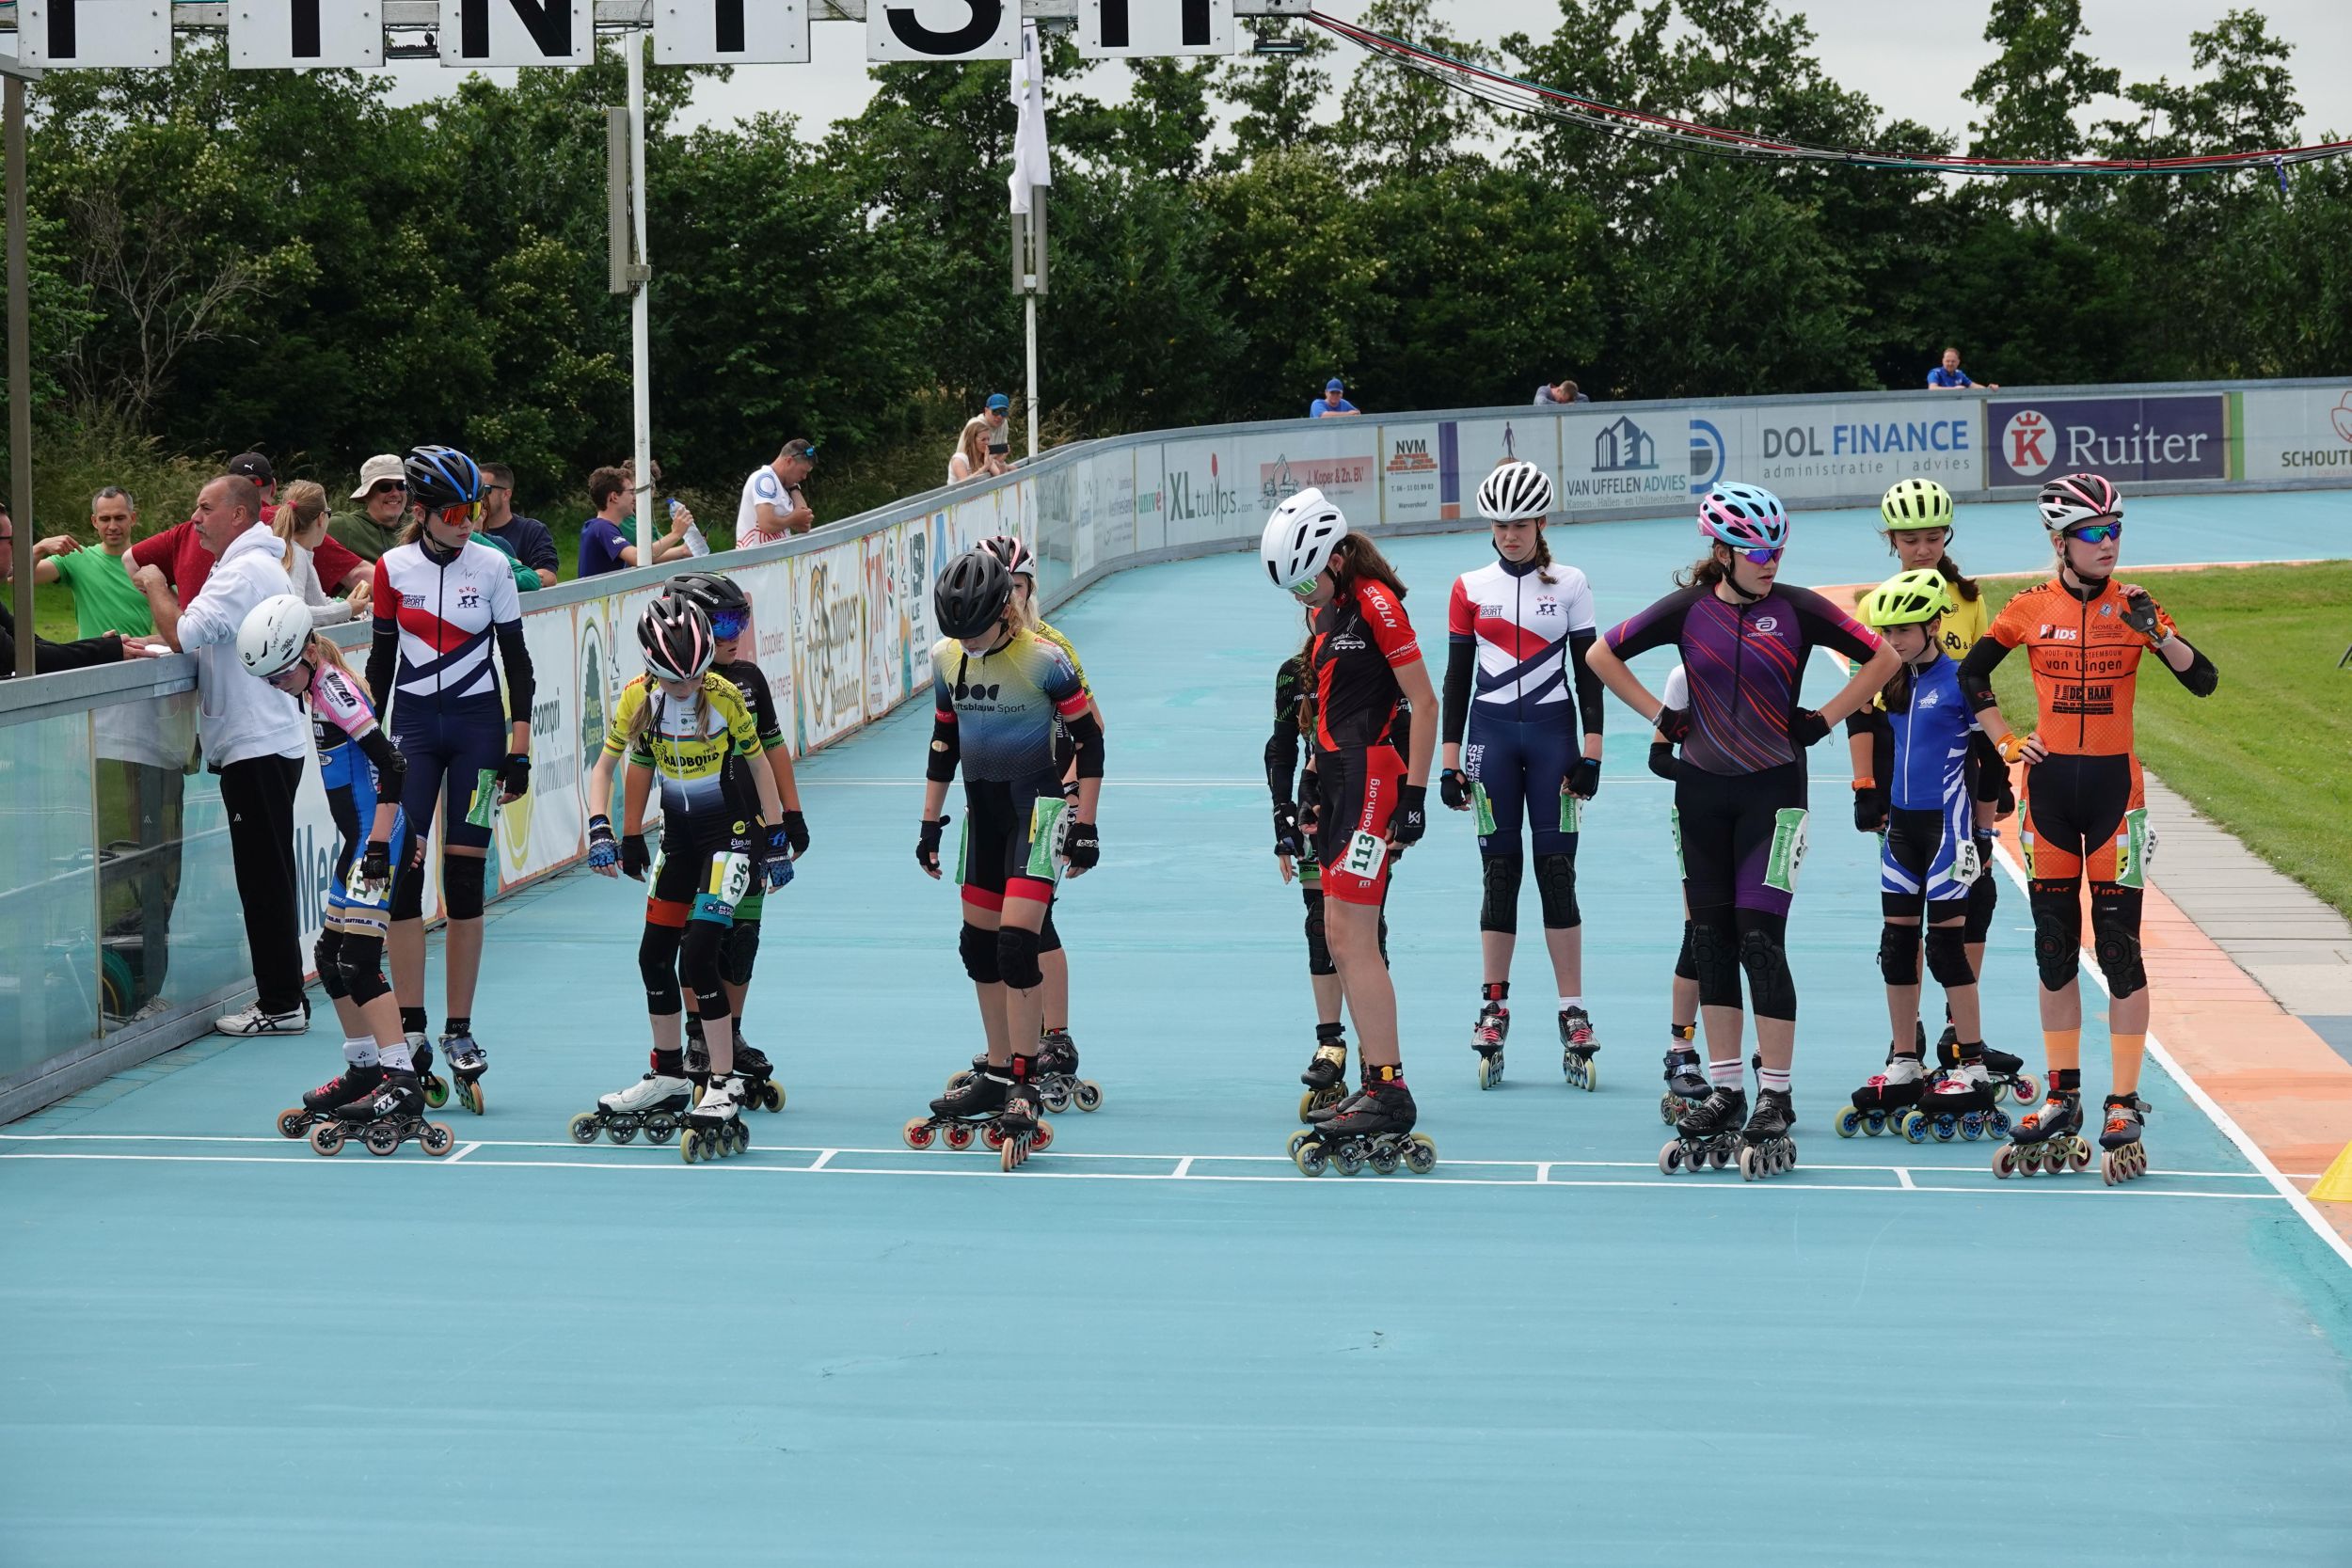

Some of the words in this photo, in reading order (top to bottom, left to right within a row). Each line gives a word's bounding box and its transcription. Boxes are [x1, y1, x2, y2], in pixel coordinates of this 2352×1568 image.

[1396, 439, 1426, 454] NVM
[1763, 426, 1824, 459] DOL
[1833, 420, 1969, 455] FINANCE
[2066, 423, 2209, 467] Ruiter
[1313, 467, 1333, 488] Koper
[1335, 469, 1341, 483] &
[1763, 461, 1883, 479] administratie
[1913, 456, 1970, 471] advies
[1566, 480, 1590, 497] VAN
[1592, 476, 1642, 495] UFFELEN
[1644, 474, 1686, 492] ADVIES
[403, 598, 426, 608] SPORT
[1371, 595, 1398, 628] KÖLN
[1480, 608, 1502, 616] SPORT
[2054, 628, 2077, 641] IDS
[2045, 660, 2069, 671] van
[2075, 659, 2122, 673] Lingen
[2087, 687, 2112, 700] HAAN
[532, 687, 561, 744] compri
[997, 704, 1026, 714] Sport
[1467, 744, 1478, 783] SPOR
[1351, 833, 1375, 871] 113
[729, 862, 749, 898] 126
